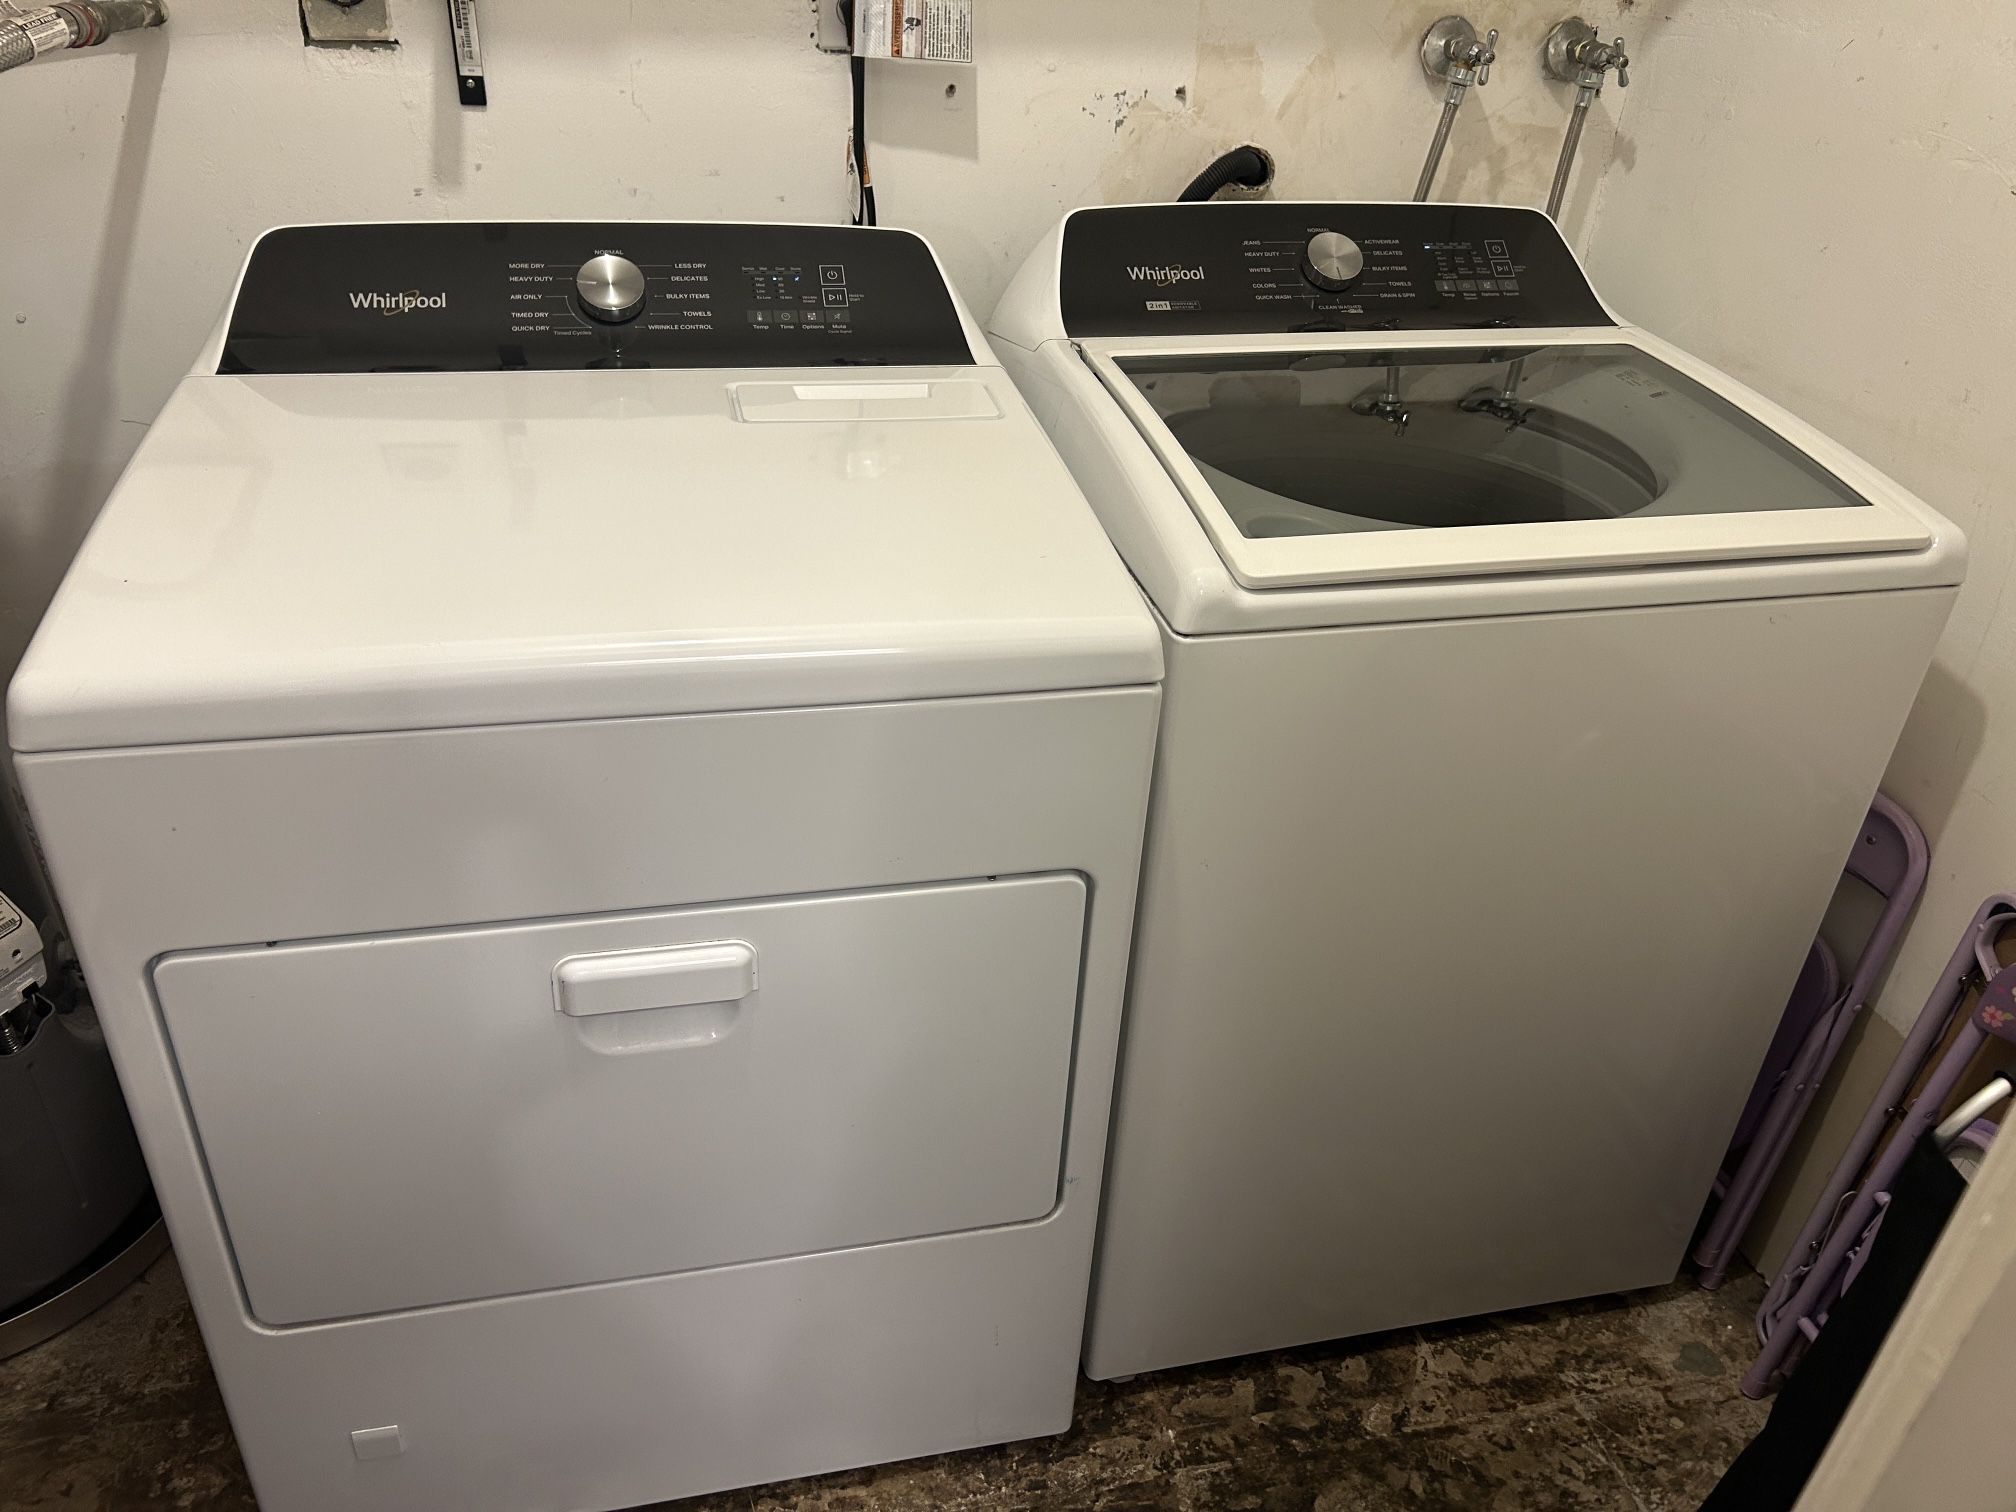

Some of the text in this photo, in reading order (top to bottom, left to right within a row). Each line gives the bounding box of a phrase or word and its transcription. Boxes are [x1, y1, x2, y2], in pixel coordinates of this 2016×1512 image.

[22, 14, 58, 29] LEAD FREE
[1126, 264, 1204, 287] Whirlpool
[349, 290, 446, 315] Whirlpool
